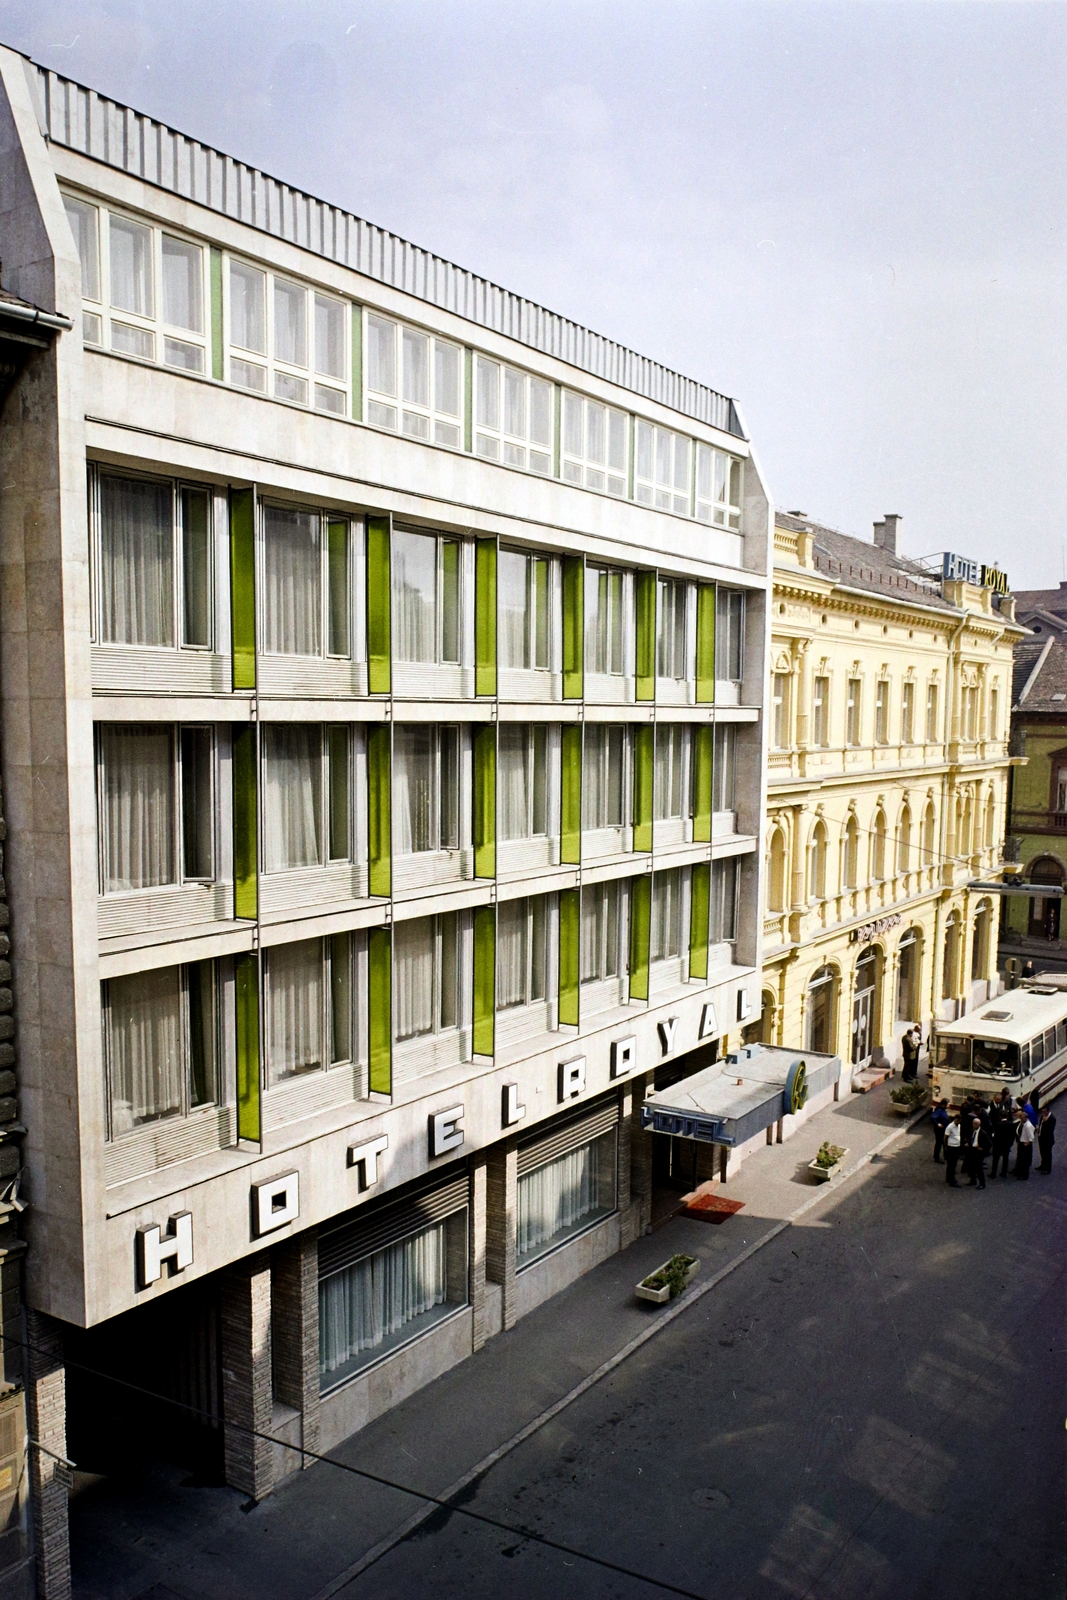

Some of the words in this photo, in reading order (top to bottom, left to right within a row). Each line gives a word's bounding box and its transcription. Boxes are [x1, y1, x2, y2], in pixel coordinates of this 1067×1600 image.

[944, 552, 981, 586] HOTEL
[981, 565, 1010, 596] ROYAL
[136, 1082, 526, 1286] HOTEL
[558, 988, 751, 1104] ROYAL
[640, 1106, 736, 1145] HOTEL
